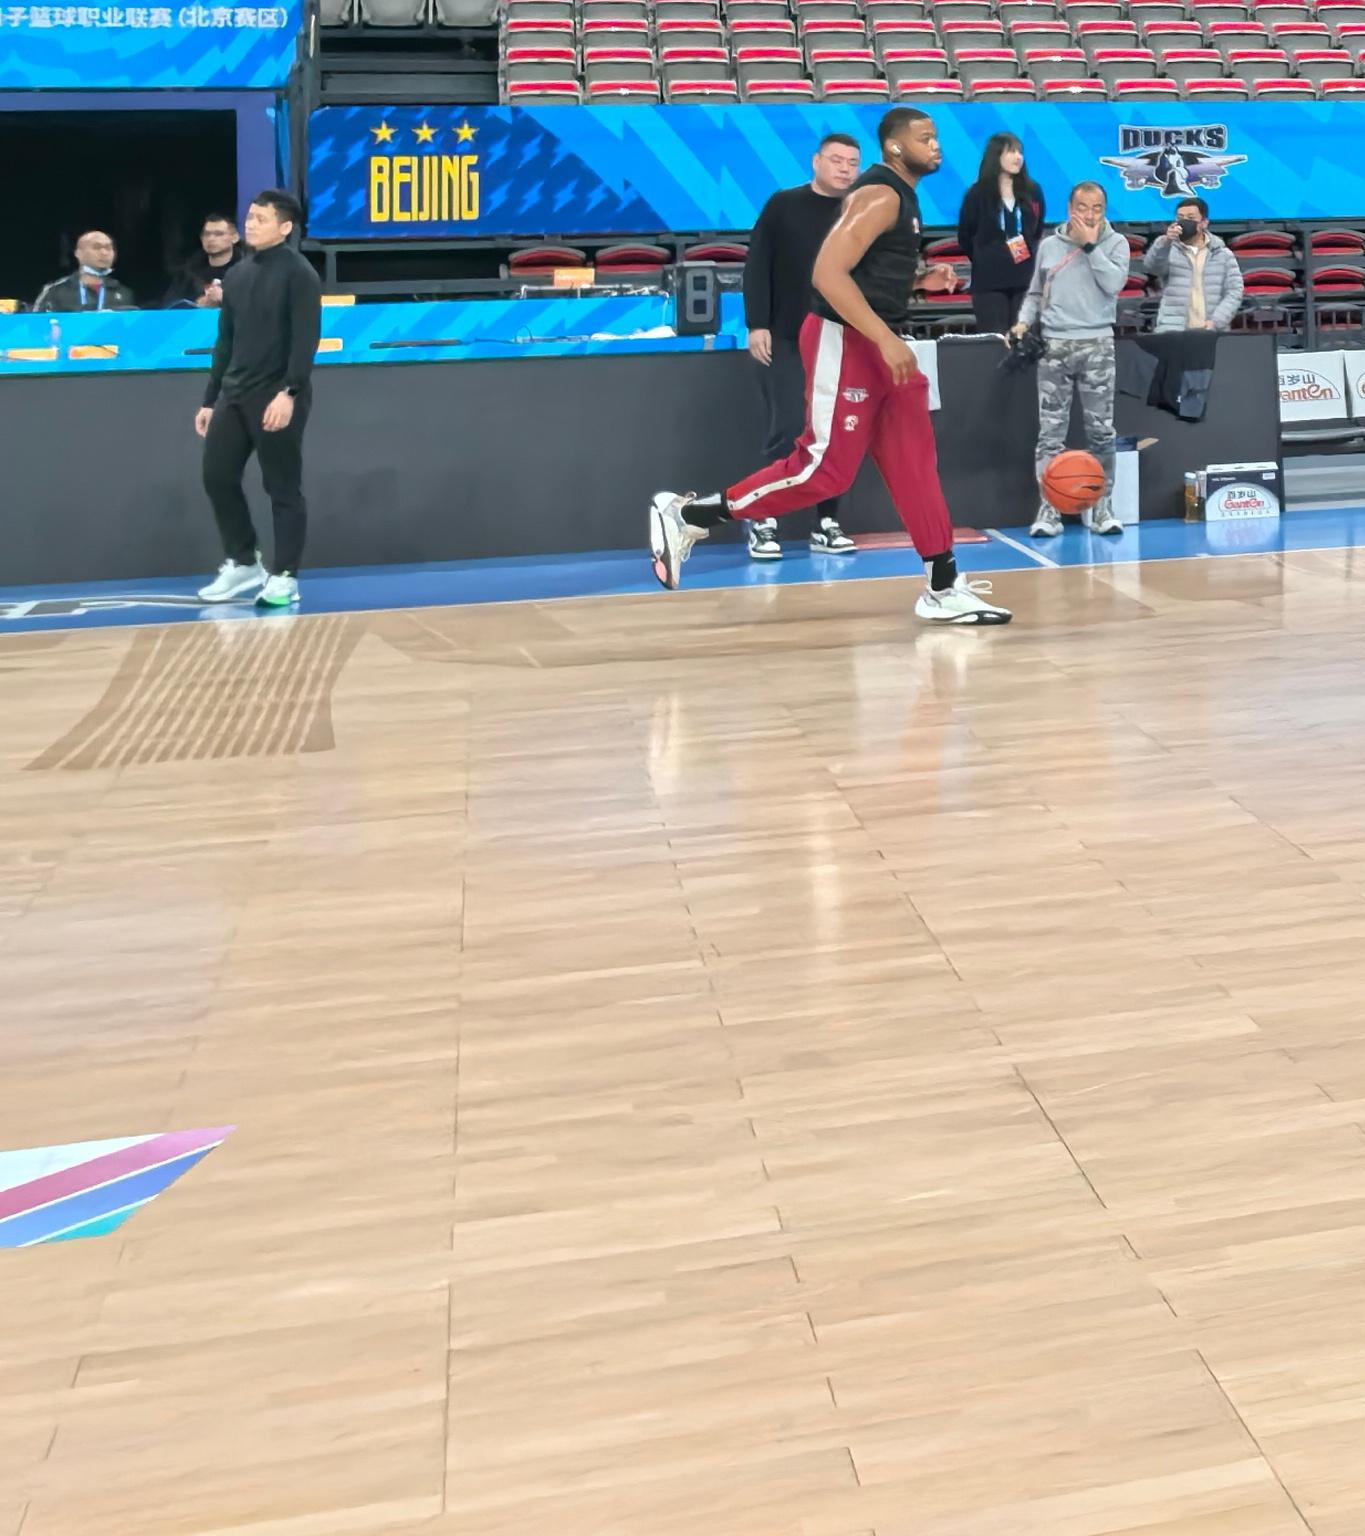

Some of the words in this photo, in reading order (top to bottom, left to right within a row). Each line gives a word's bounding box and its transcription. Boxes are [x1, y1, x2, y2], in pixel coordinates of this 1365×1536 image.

[0, 1, 288, 29] 子篮球职业联赛（北京赛区）
[1121, 126, 1226, 152] DUCKS
[370, 155, 480, 222] BEIJING
[1280, 383, 1335, 402] anten
